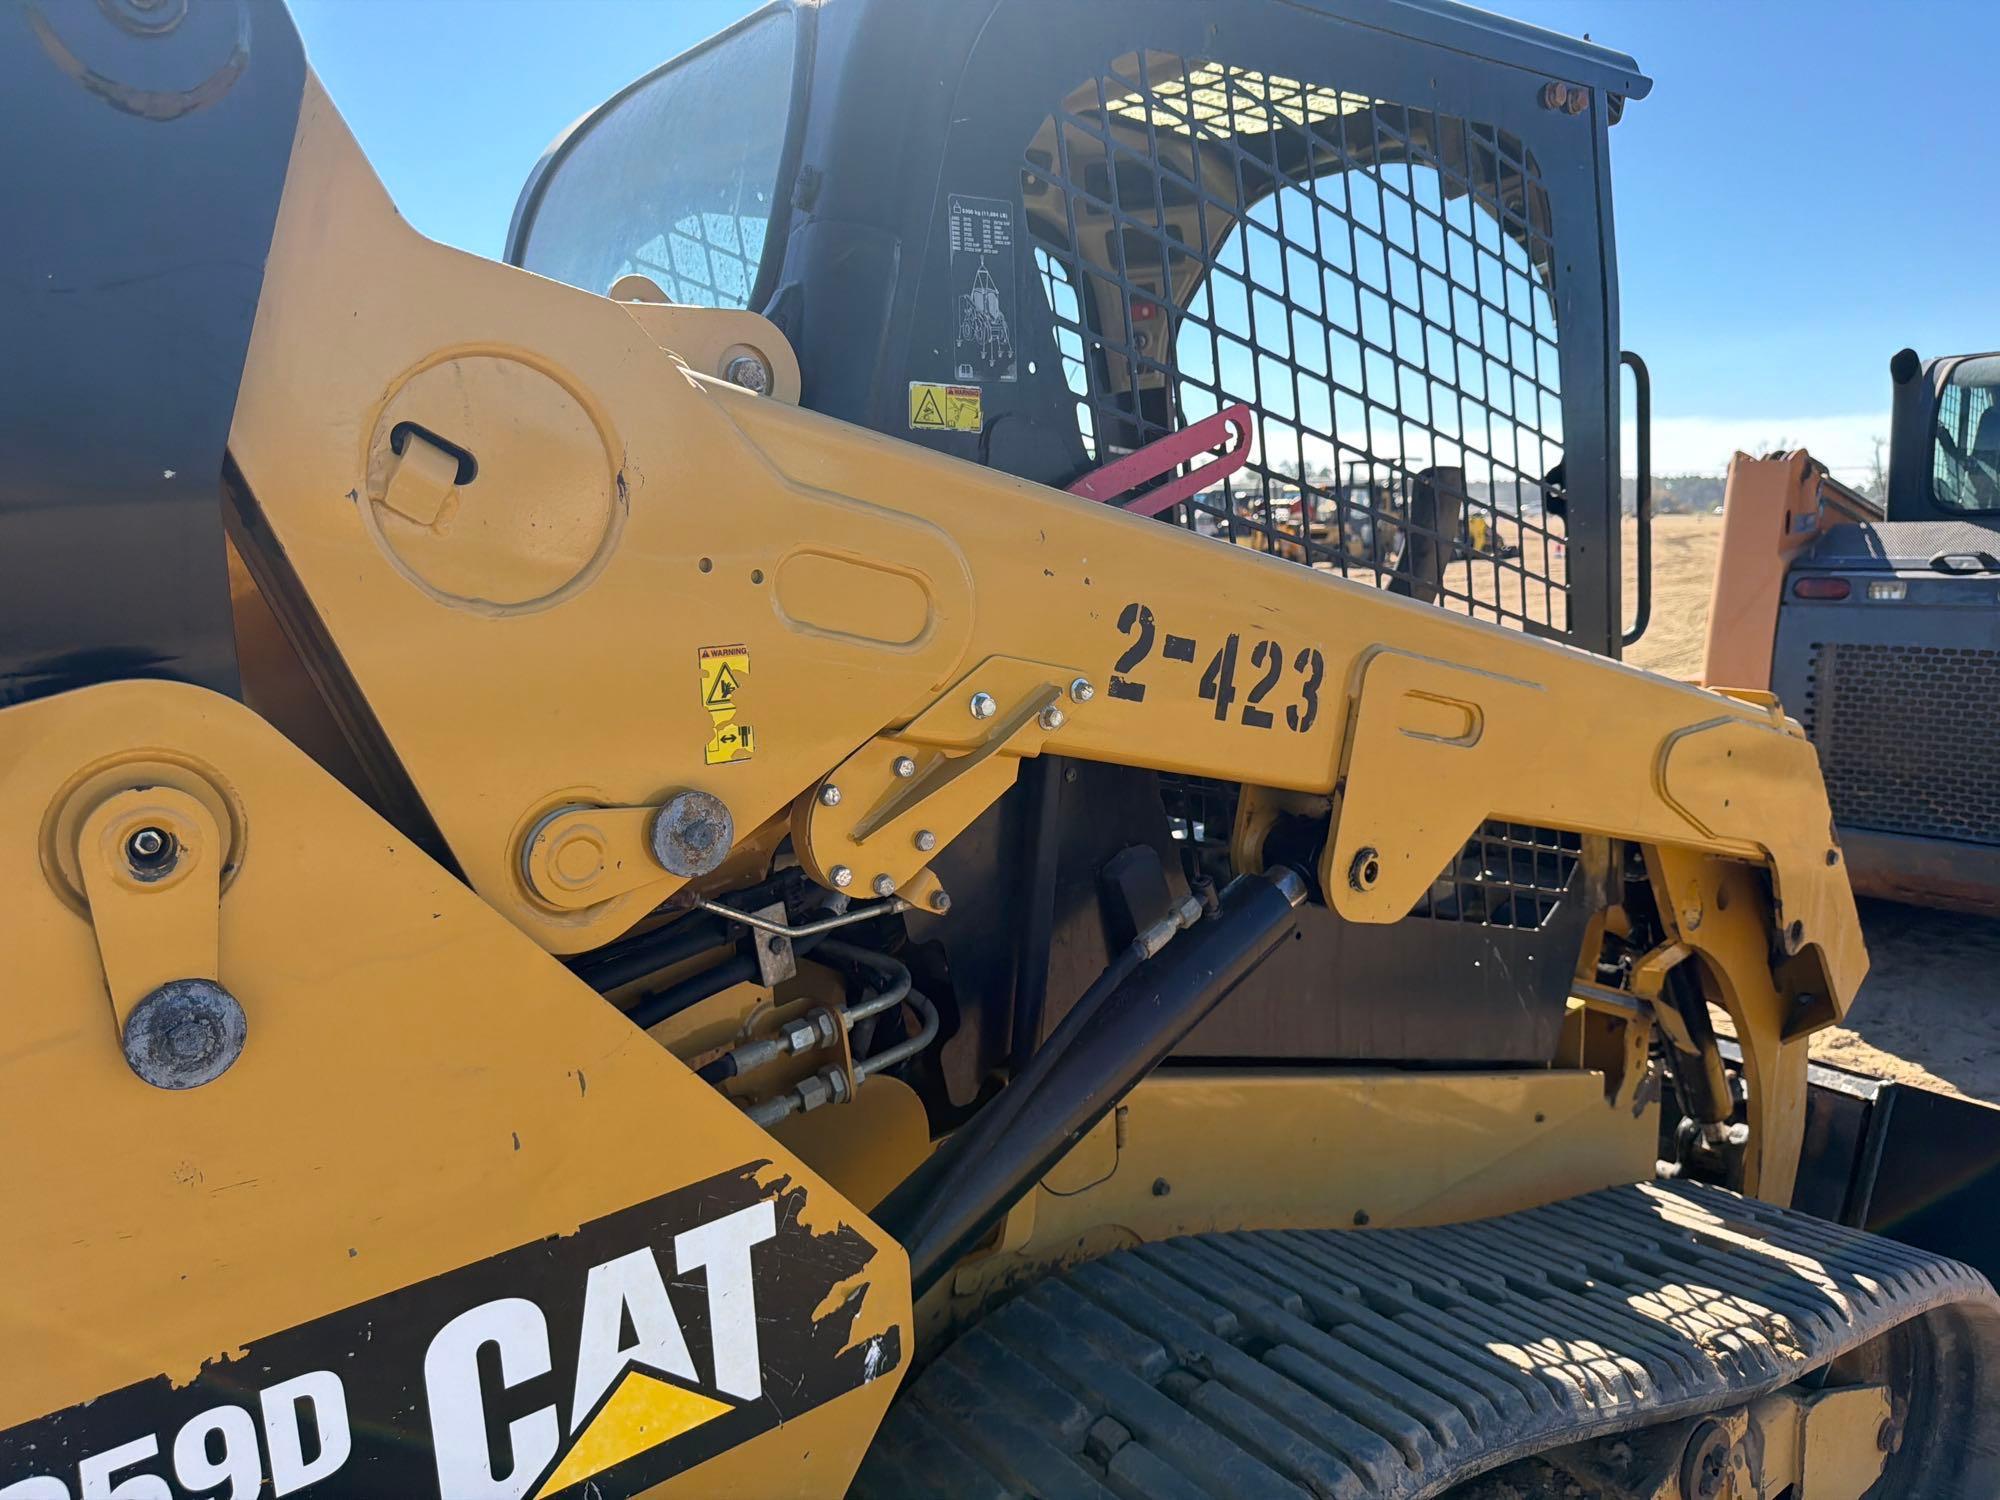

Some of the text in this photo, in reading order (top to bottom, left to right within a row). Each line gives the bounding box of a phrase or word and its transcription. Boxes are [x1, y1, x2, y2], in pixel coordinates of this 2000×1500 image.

[711, 647, 747, 657] WARNING
[1108, 603, 1324, 733] 2-423
[424, 1200, 776, 1500] CAT
[0, 1370, 351, 1500] 59D
